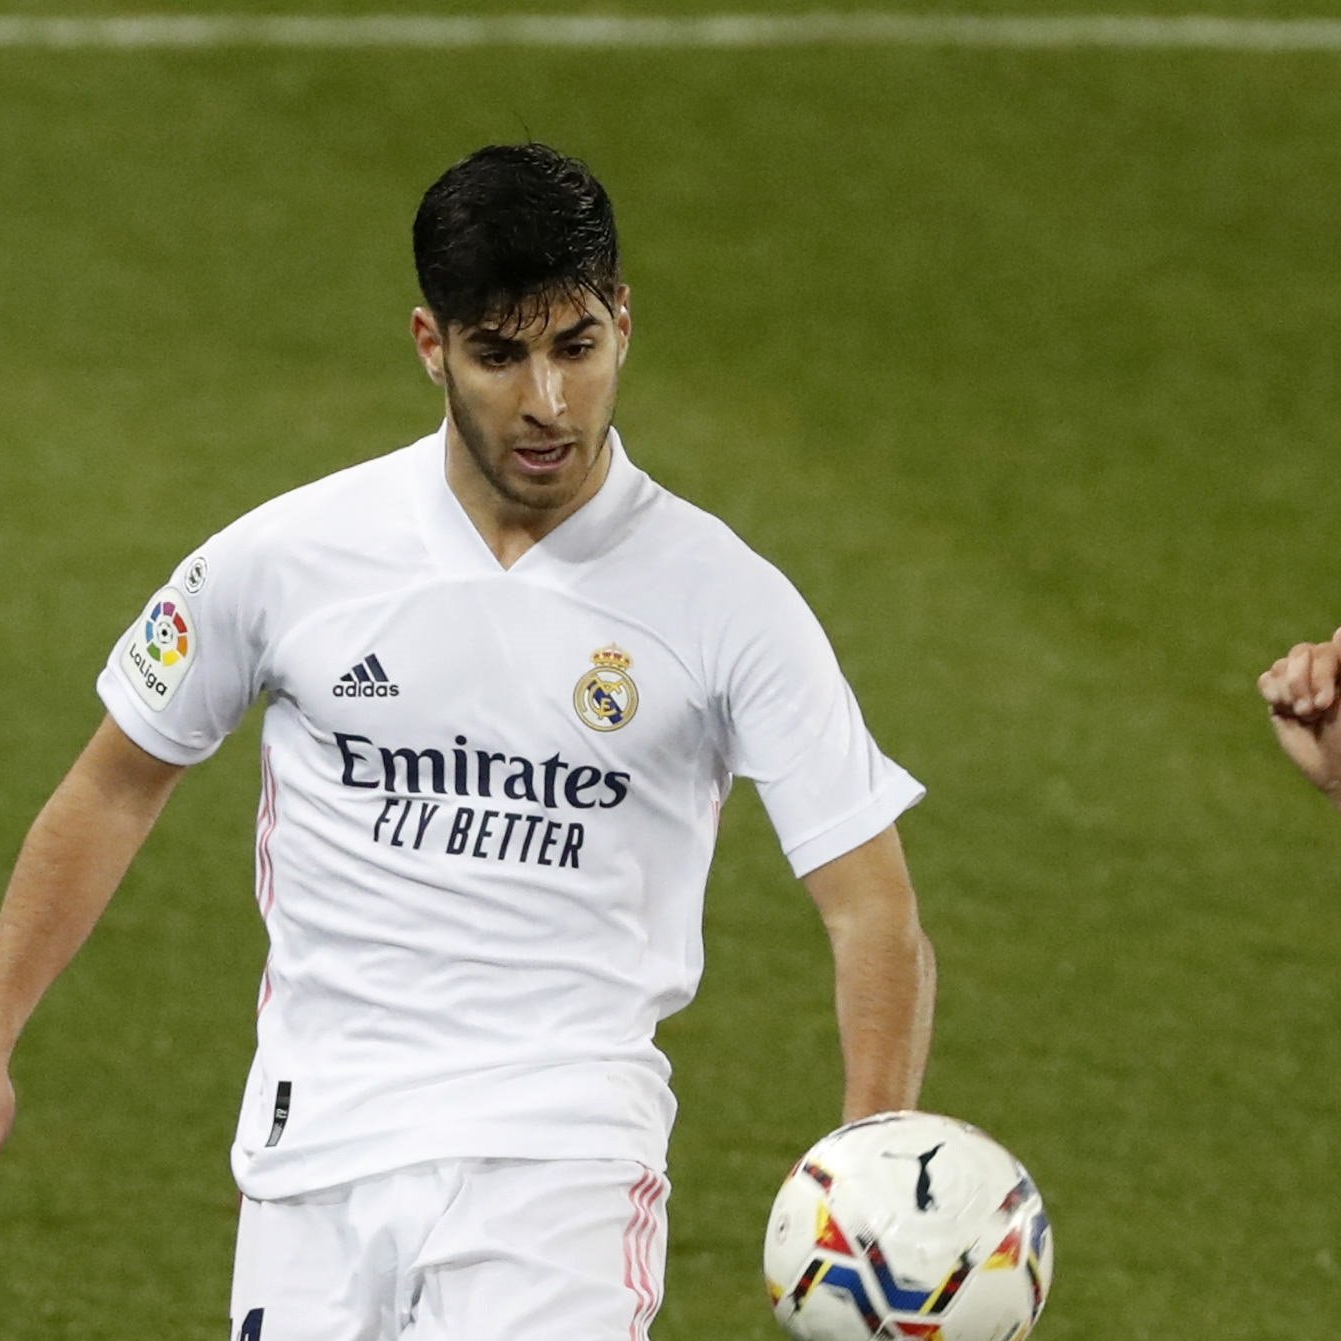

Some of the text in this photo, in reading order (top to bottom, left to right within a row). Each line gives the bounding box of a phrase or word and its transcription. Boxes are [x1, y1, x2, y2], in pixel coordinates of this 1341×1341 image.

[129, 643, 168, 696] LaLiga
[332, 681, 400, 698] adidas
[332, 731, 631, 809] Emirates
[373, 799, 585, 869] FLY BETTER
